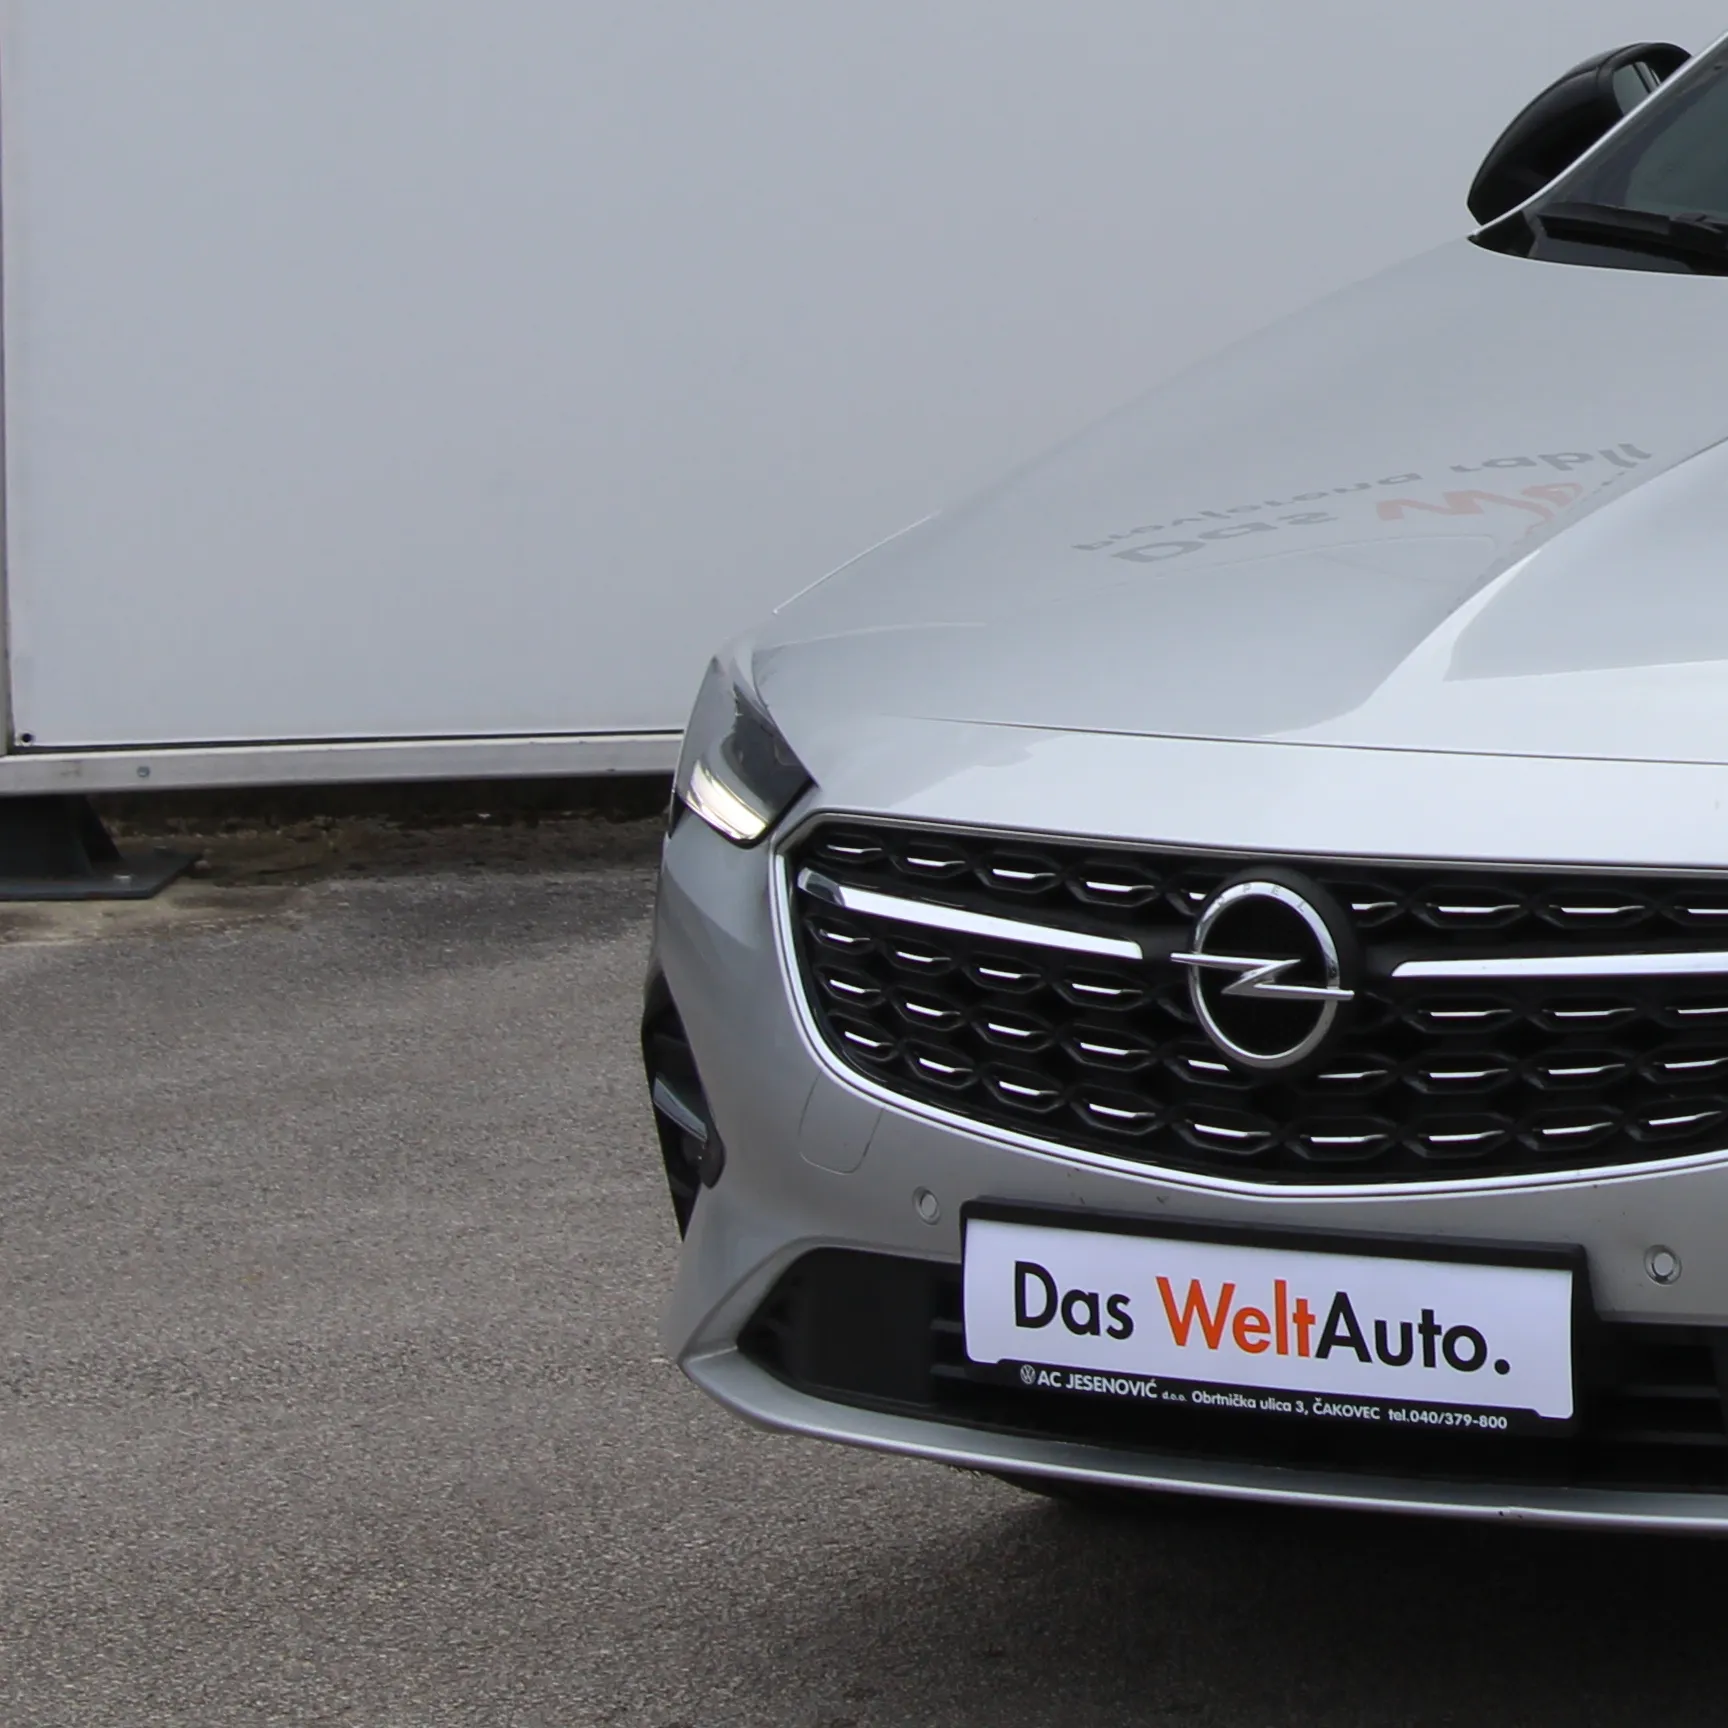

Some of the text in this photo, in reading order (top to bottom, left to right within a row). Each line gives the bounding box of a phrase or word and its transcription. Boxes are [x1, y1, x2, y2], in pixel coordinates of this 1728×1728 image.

[1013, 1259, 1511, 1376] Das WeltAuto.
[1037, 1370, 1062, 1388] AC
[1065, 1373, 1158, 1399] JESENOVIĆ
[1191, 1390, 1257, 1409] Obrtnička
[1259, 1397, 1292, 1412] ulica
[1295, 1400, 1309, 1416] 3,
[1312, 1397, 1381, 1420] ČAKOVEC
